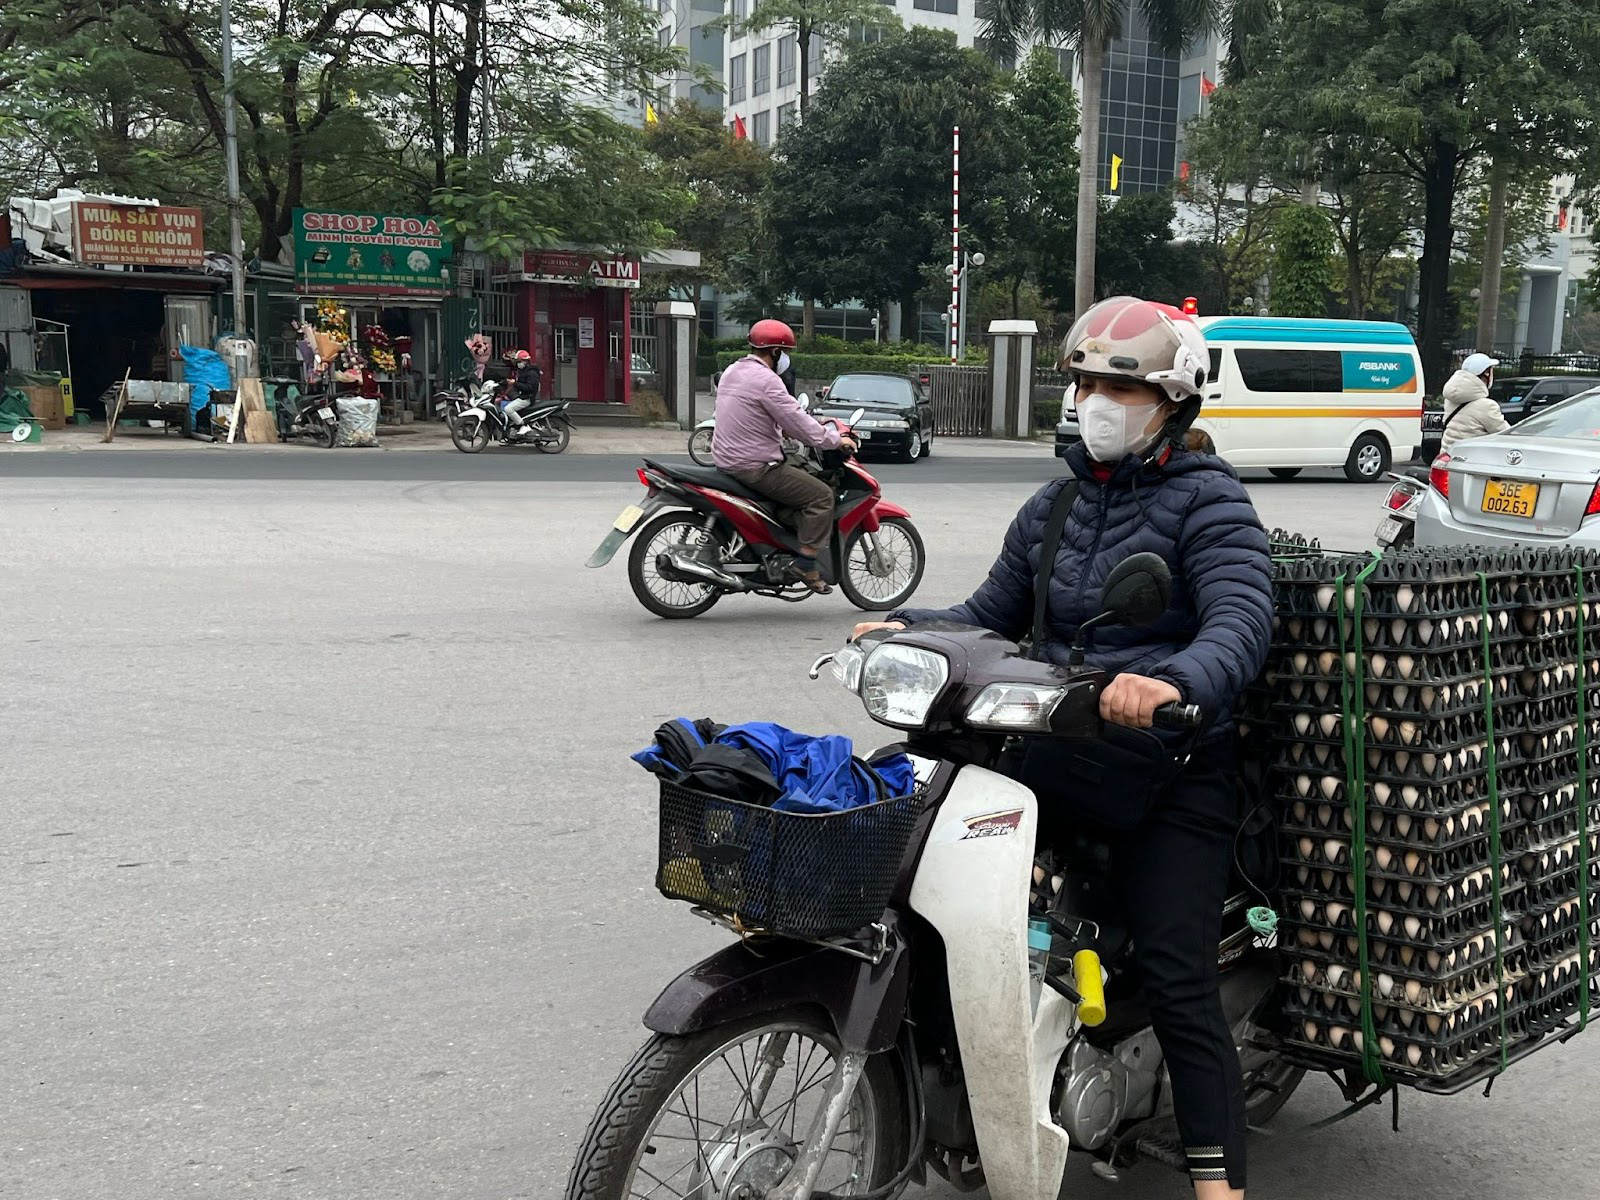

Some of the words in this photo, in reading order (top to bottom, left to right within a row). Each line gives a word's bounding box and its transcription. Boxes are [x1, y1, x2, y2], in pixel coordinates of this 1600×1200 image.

[83, 208, 121, 223] MUA
[163, 213, 196, 229] VỤN
[303, 212, 377, 233] SHOP
[384, 217, 443, 237] HOA
[142, 229, 192, 245] NHÔM
[306, 232, 342, 243] MINH
[395, 236, 442, 248] FLOWER
[589, 260, 633, 278] ATM
[1499, 483, 1523, 498] 36E
[1487, 497, 1528, 515] 002.63
